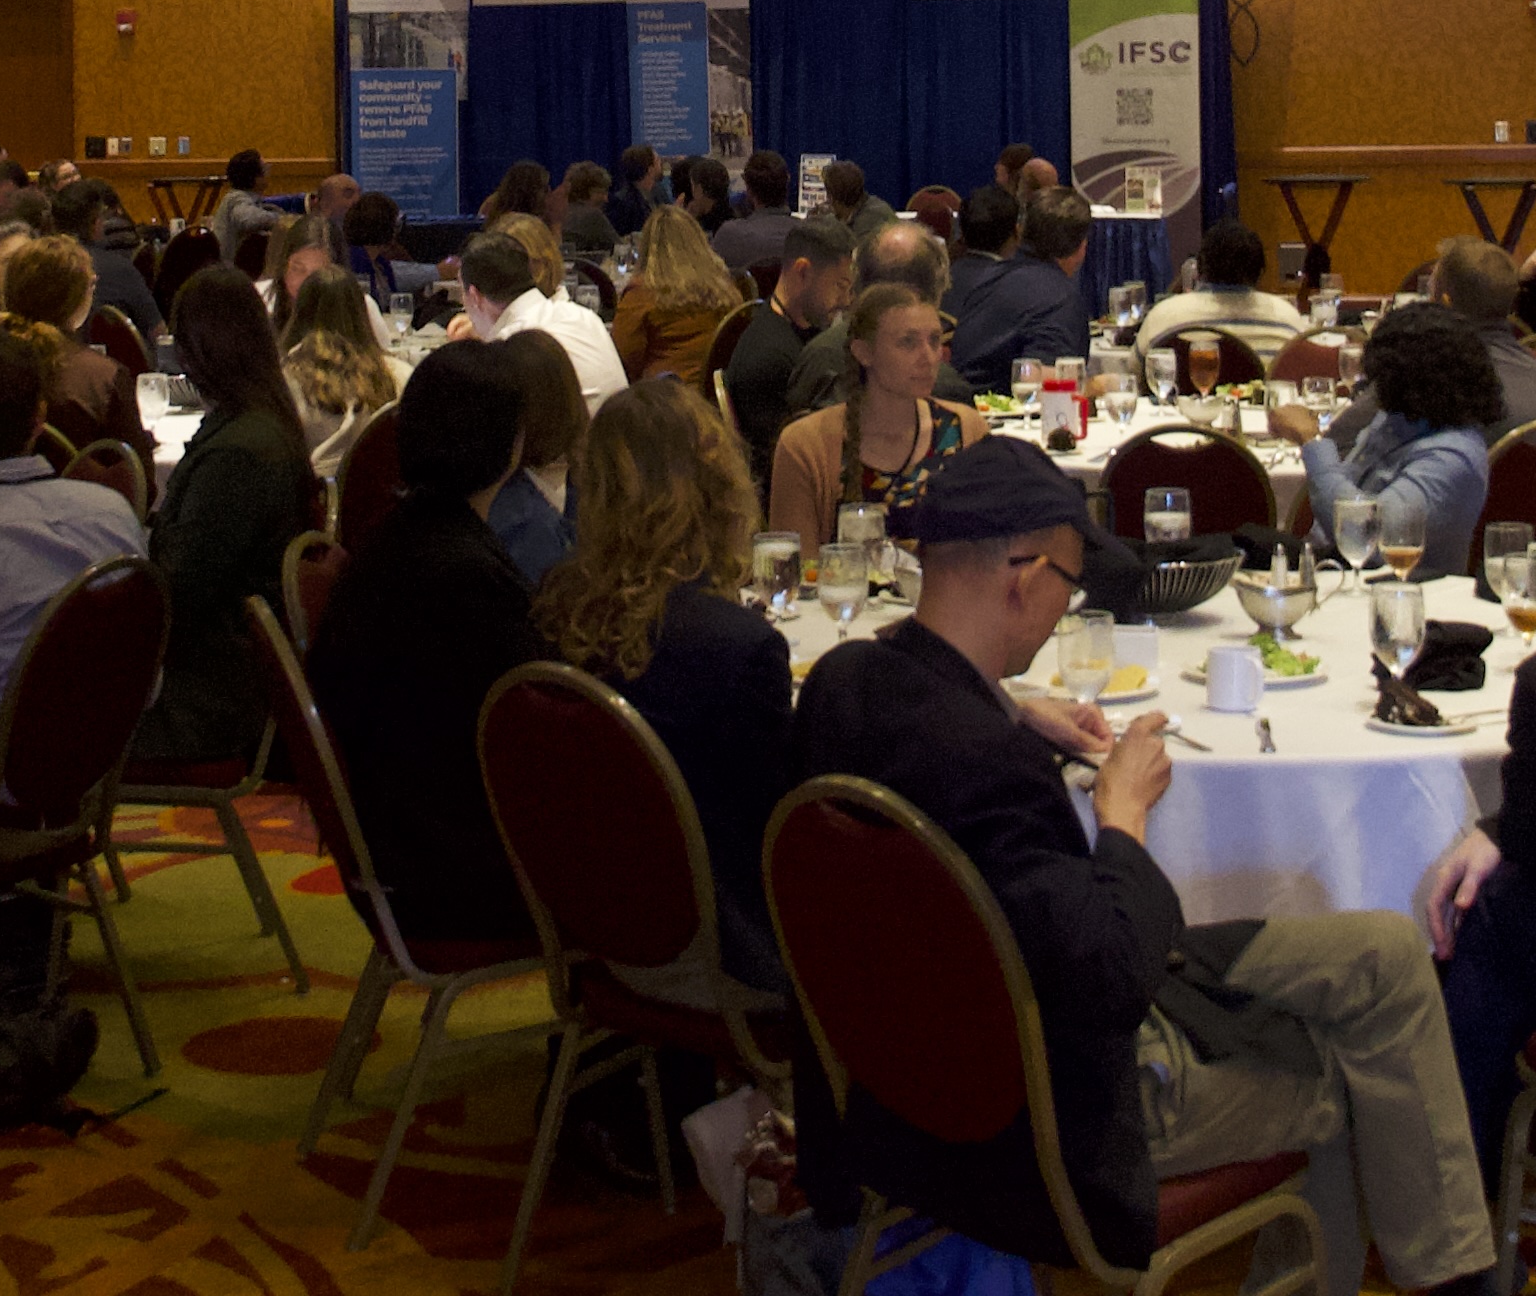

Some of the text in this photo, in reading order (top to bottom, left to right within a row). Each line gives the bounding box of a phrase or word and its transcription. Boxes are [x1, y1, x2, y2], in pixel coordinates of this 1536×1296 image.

[1118, 40, 1192, 64] IFSC
[359, 80, 443, 92] Safeguard your
[359, 93, 421, 104] community
[359, 105, 402, 115] remove
[359, 115, 428, 127] from landfill
[359, 128, 407, 139] leachate
